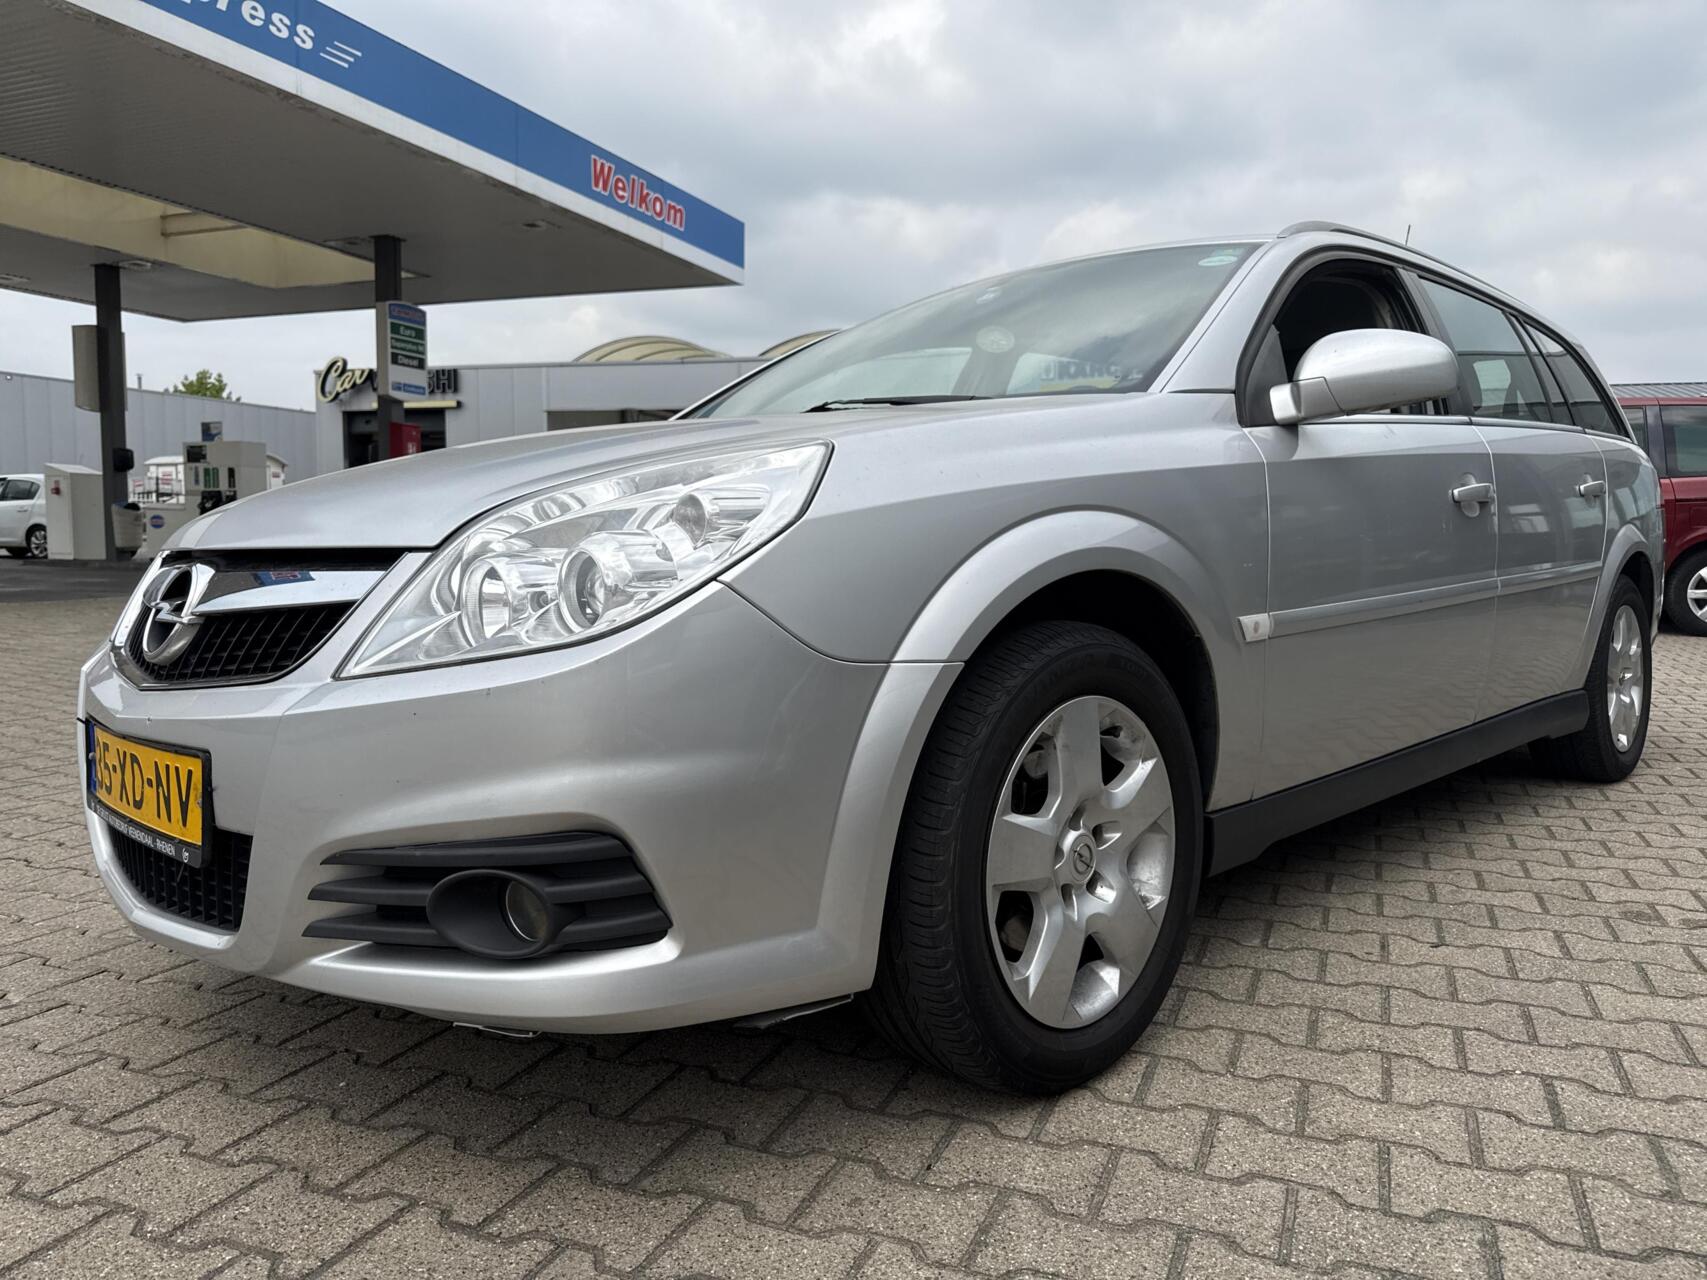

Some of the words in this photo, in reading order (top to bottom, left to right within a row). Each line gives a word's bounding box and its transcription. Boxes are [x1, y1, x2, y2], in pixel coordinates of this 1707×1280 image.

[591, 155, 685, 232] Welkom
[318, 356, 372, 403] Car
[96, 735, 193, 828] 35-XD-NV
